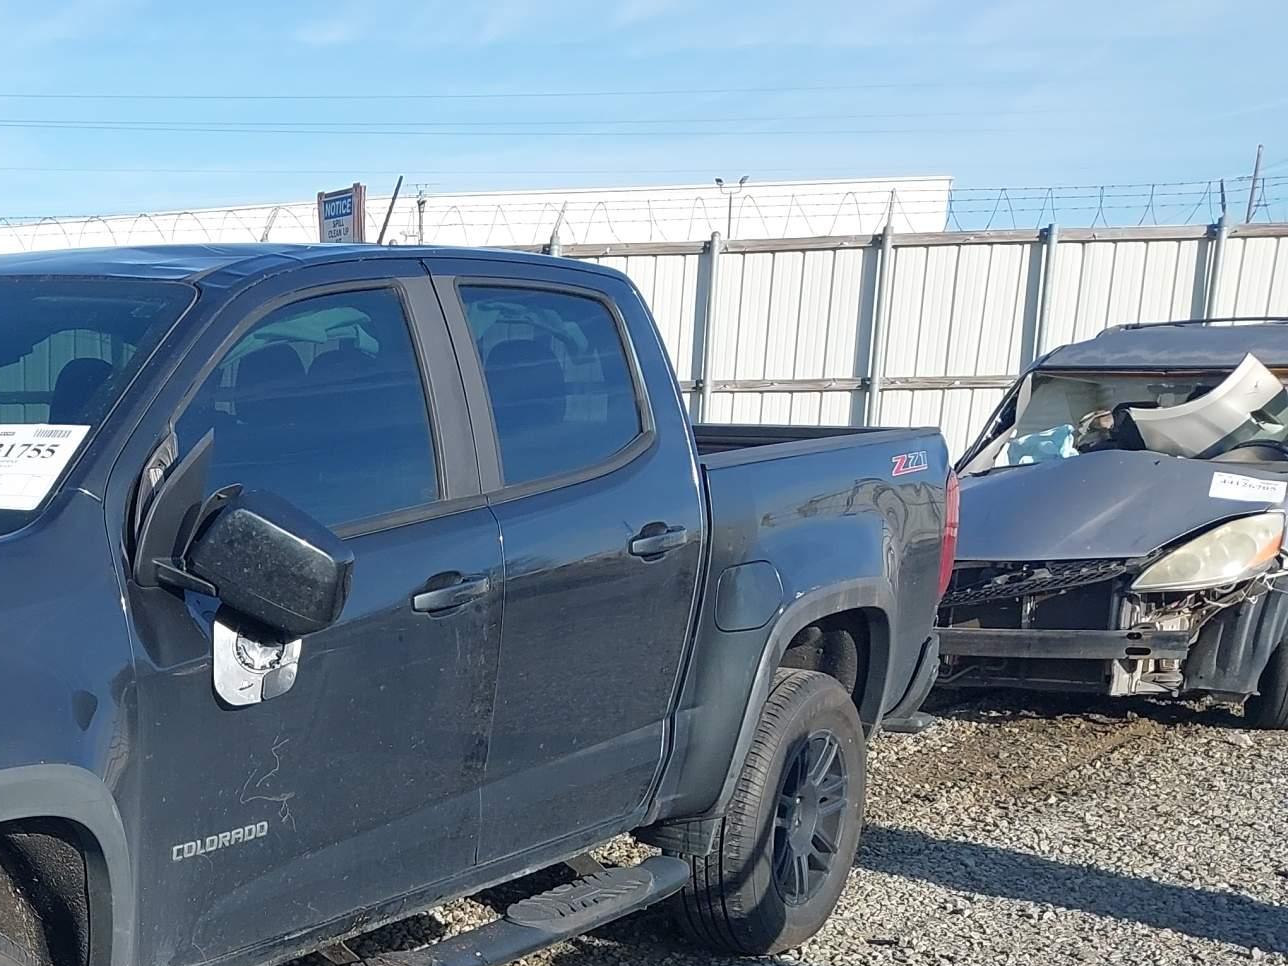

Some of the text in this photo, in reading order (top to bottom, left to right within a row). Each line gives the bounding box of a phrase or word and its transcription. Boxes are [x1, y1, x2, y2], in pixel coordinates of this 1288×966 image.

[325, 198, 351, 216] NOTICE
[892, 451, 928, 477] Z71
[172, 820, 269, 861] COLORADO
